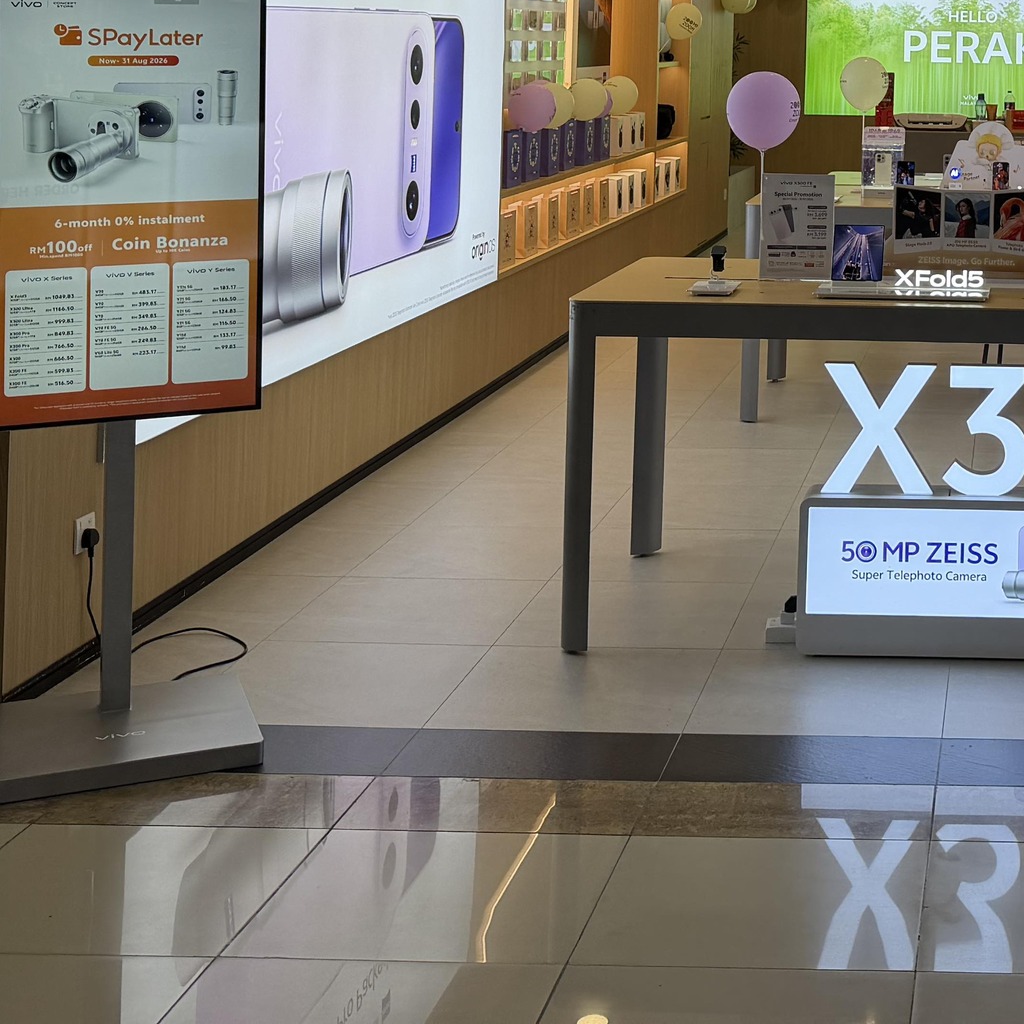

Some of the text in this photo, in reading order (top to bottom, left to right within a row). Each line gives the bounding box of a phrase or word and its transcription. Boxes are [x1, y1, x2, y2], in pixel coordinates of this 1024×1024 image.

[11, 0, 42, 8] vivo
[948, 10, 998, 24] HELLO
[88, 28, 204, 51] SPayLater
[132, 57, 148, 67] Aug
[54, 214, 205, 228] 6-month 0% instalment
[112, 235, 229, 251] Coin Bonanza
[918, 256, 1015, 266] ZEISS Image. Go Further.
[894, 269, 984, 288] XFold5
[882, 542, 919, 564] MP
[926, 542, 998, 565] ZEISS
[851, 569, 987, 584] Super Telephoto Camera
[95, 730, 146, 741] vivo
